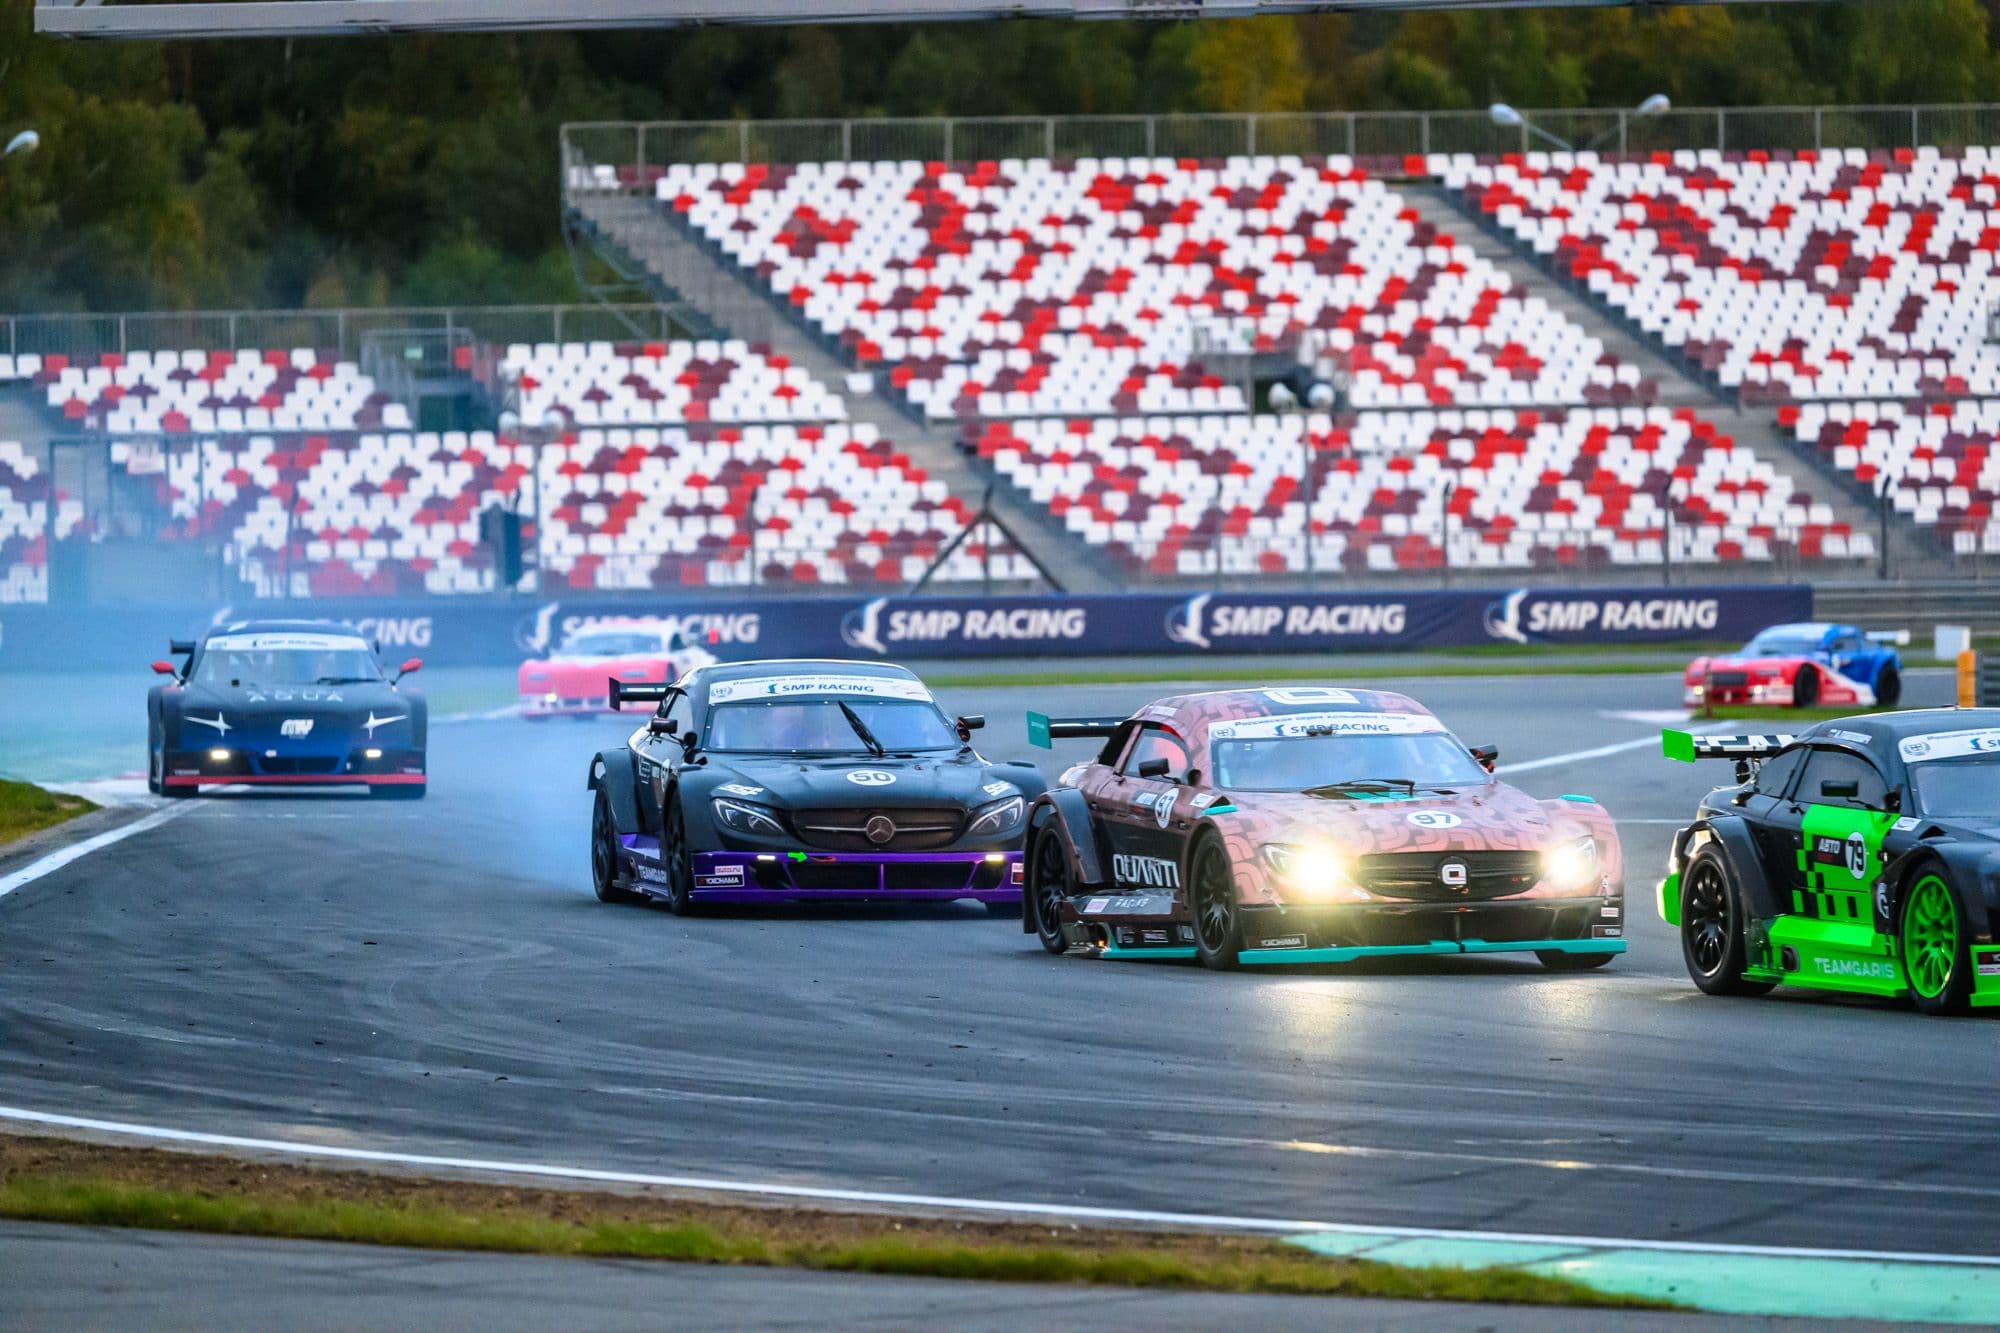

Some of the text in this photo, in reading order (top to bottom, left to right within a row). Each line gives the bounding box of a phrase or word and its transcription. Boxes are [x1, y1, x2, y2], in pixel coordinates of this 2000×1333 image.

[887, 608, 1086, 641] SMP RACING
[1210, 604, 1406, 636] SMP RACING
[1527, 599, 1718, 632] SMP RACING
[782, 683, 874, 692] SMP RACING
[1330, 723, 1390, 732] RACING
[853, 772, 891, 781] 50
[1414, 813, 1451, 824] 97
[1848, 839, 1864, 872] 79
[1813, 956, 1895, 980] TEAMGARIS
